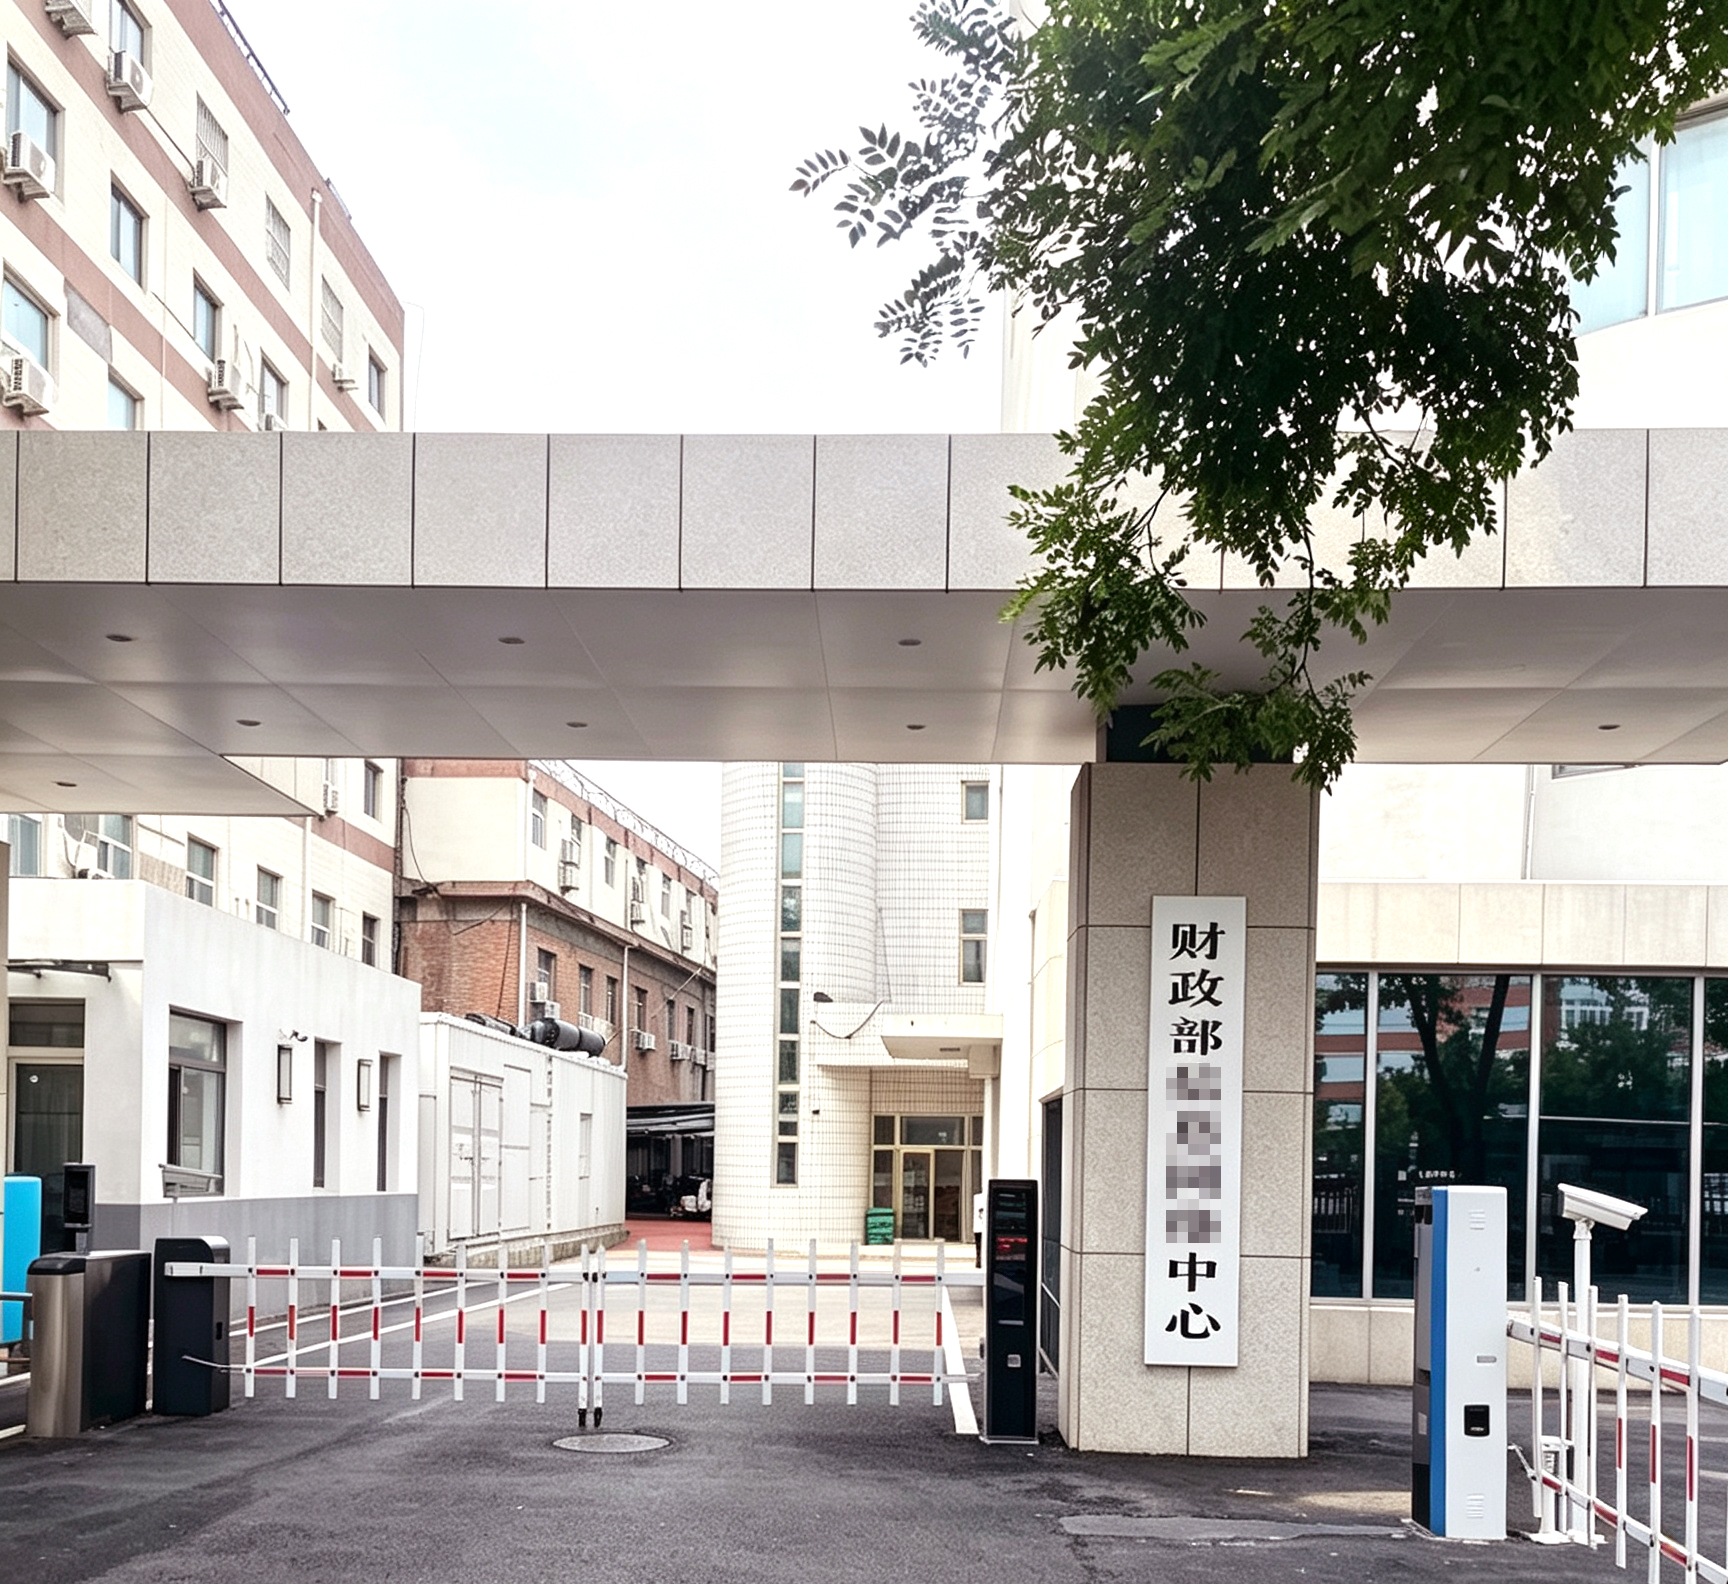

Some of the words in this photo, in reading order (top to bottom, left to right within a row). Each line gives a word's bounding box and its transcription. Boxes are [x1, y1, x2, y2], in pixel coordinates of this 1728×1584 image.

[1165, 922, 1226, 1339] 财政部中心
